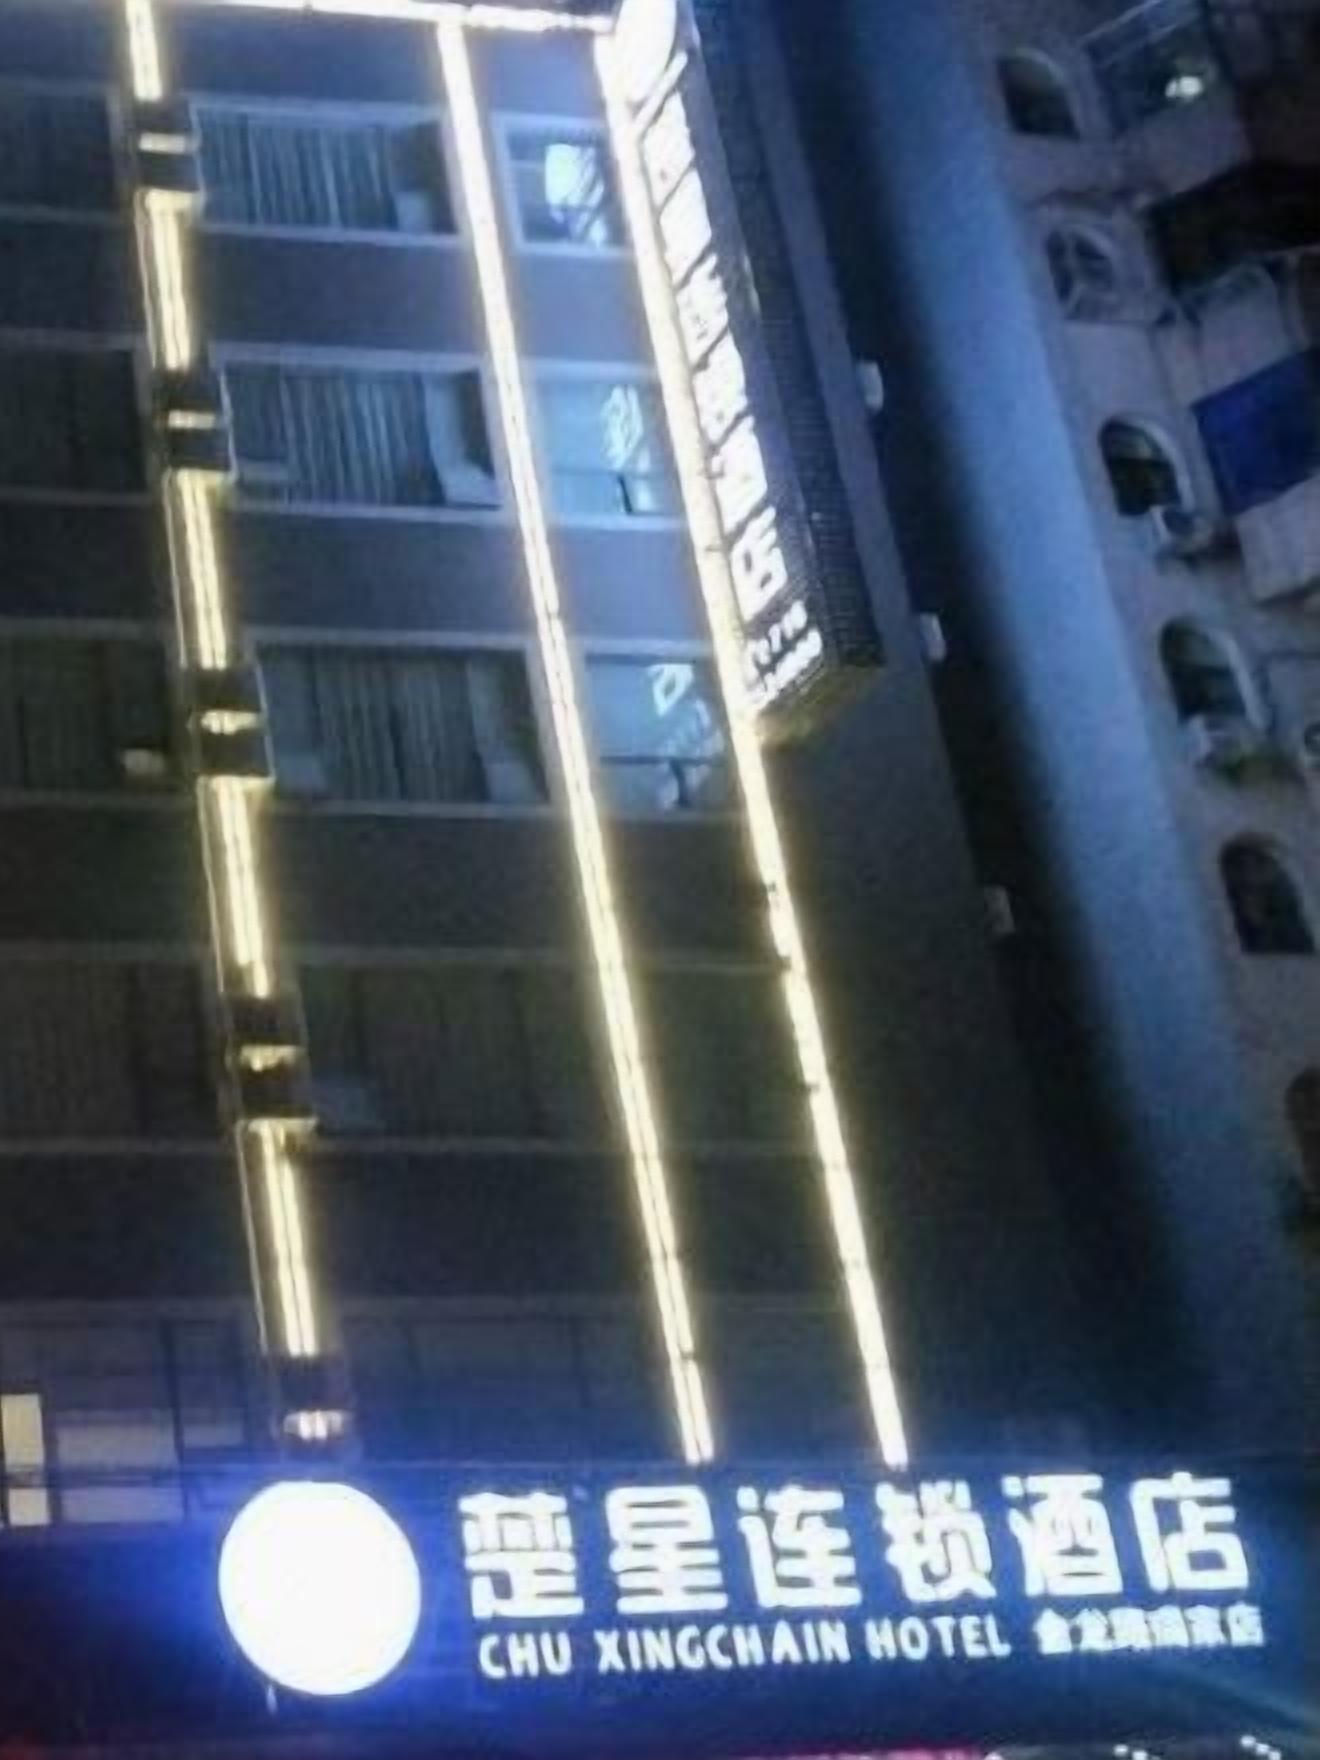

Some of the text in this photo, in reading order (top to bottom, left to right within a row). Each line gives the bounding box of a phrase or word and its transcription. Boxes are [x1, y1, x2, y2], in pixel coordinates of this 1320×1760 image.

[458, 1471, 1249, 1619] 楚星连锁酒店
[479, 1613, 1011, 1679] CHU XINGCHAIN HOTEL
